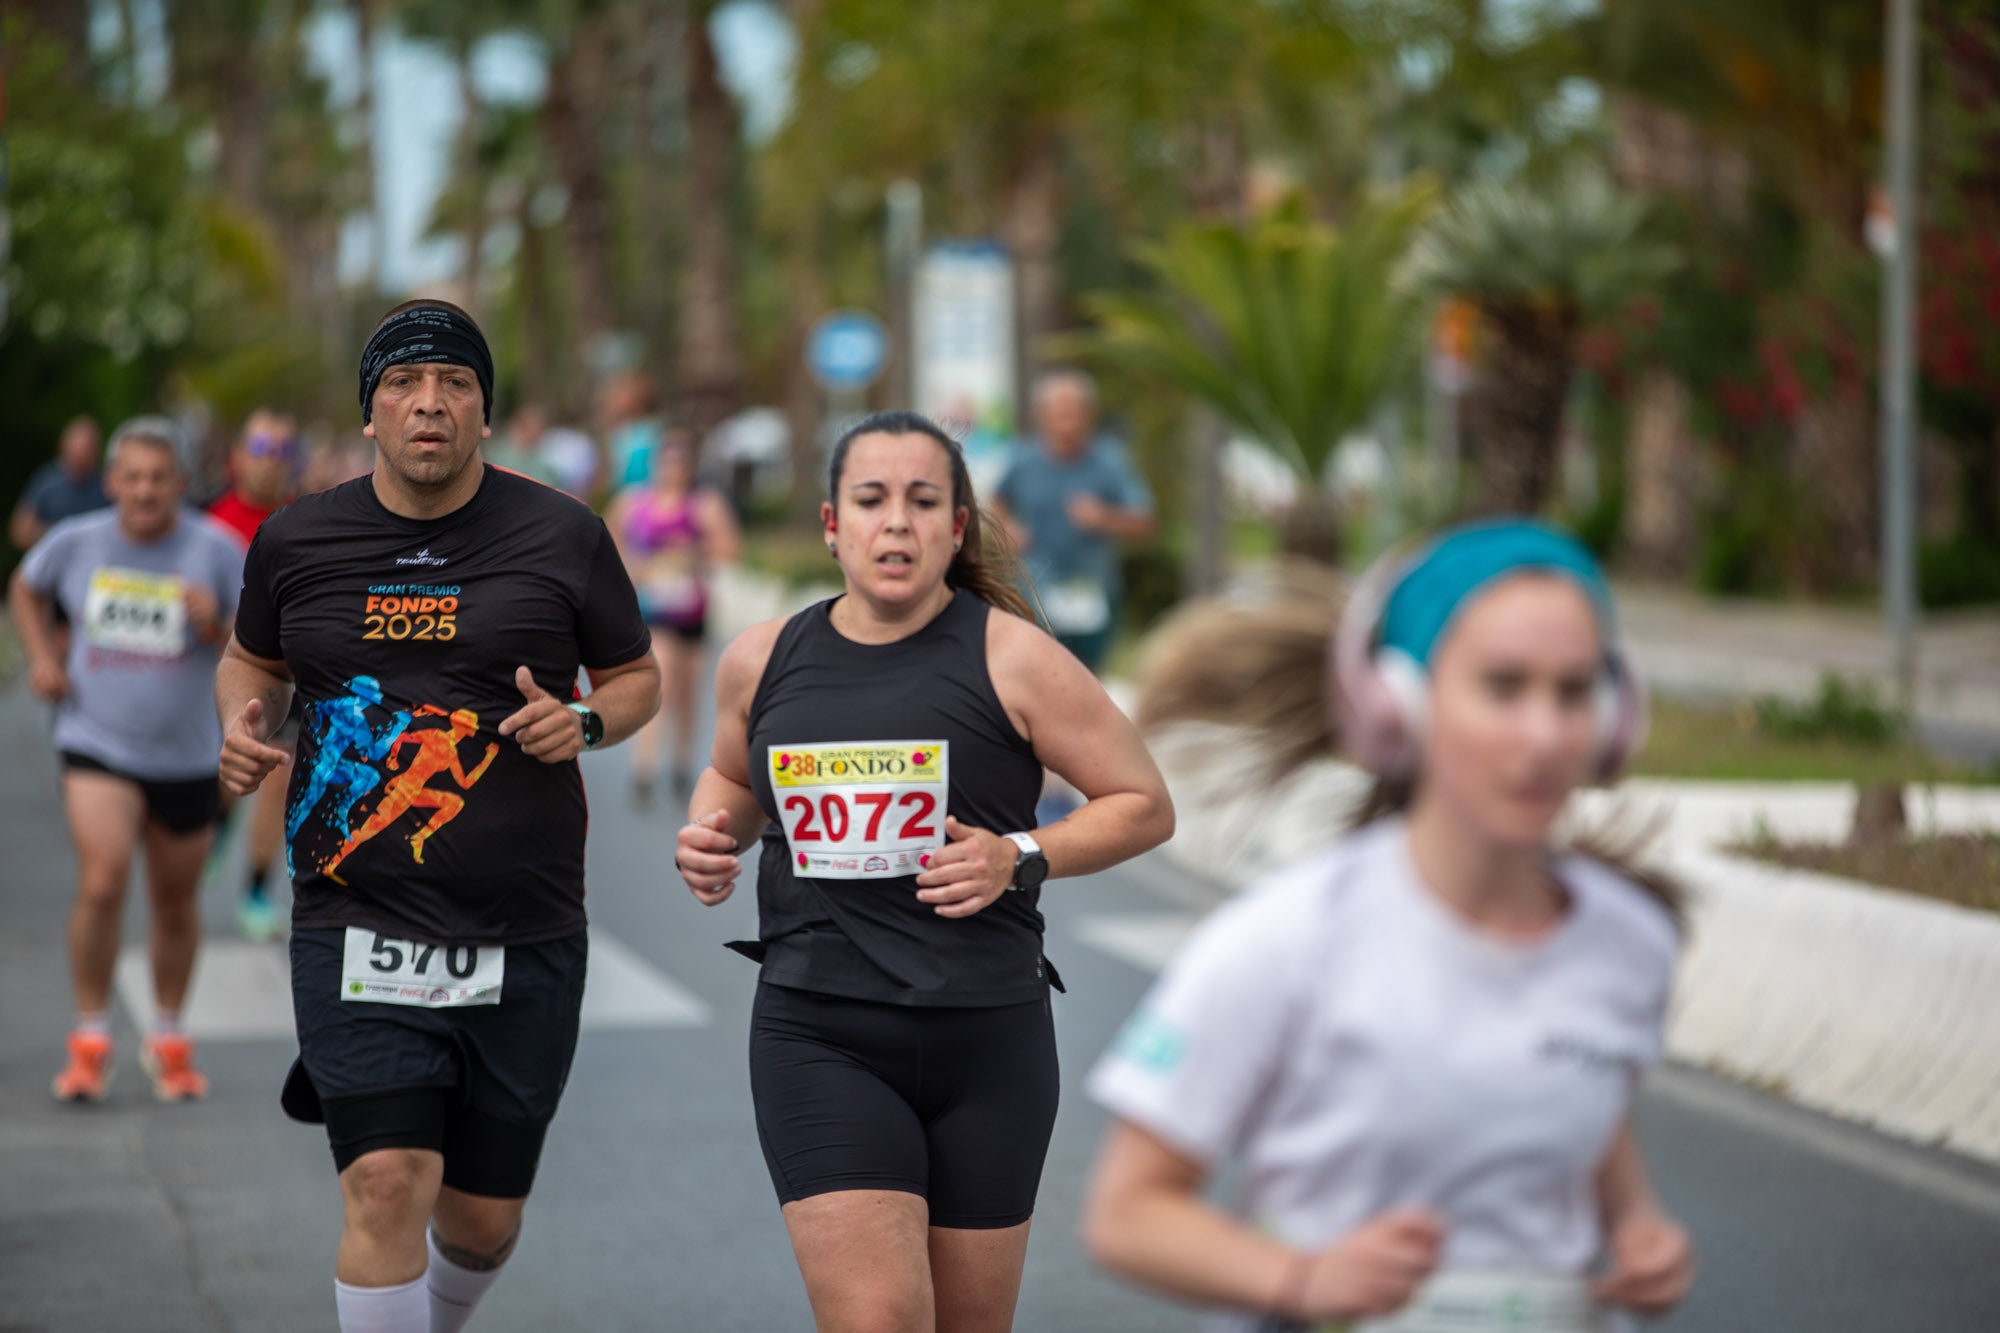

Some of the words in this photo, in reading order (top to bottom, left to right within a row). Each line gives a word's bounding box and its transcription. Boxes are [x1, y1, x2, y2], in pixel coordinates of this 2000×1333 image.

[368, 584, 406, 594] GRAN
[409, 584, 462, 596] PREMIO
[365, 596, 459, 615] FONDO
[361, 614, 457, 641] 2025
[820, 751, 851, 760] GRAN
[854, 749, 897, 758] PREMIO
[790, 755, 816, 777] 38
[816, 758, 906, 777] FONDO
[784, 791, 937, 843] 2072
[368, 932, 479, 980] 570
